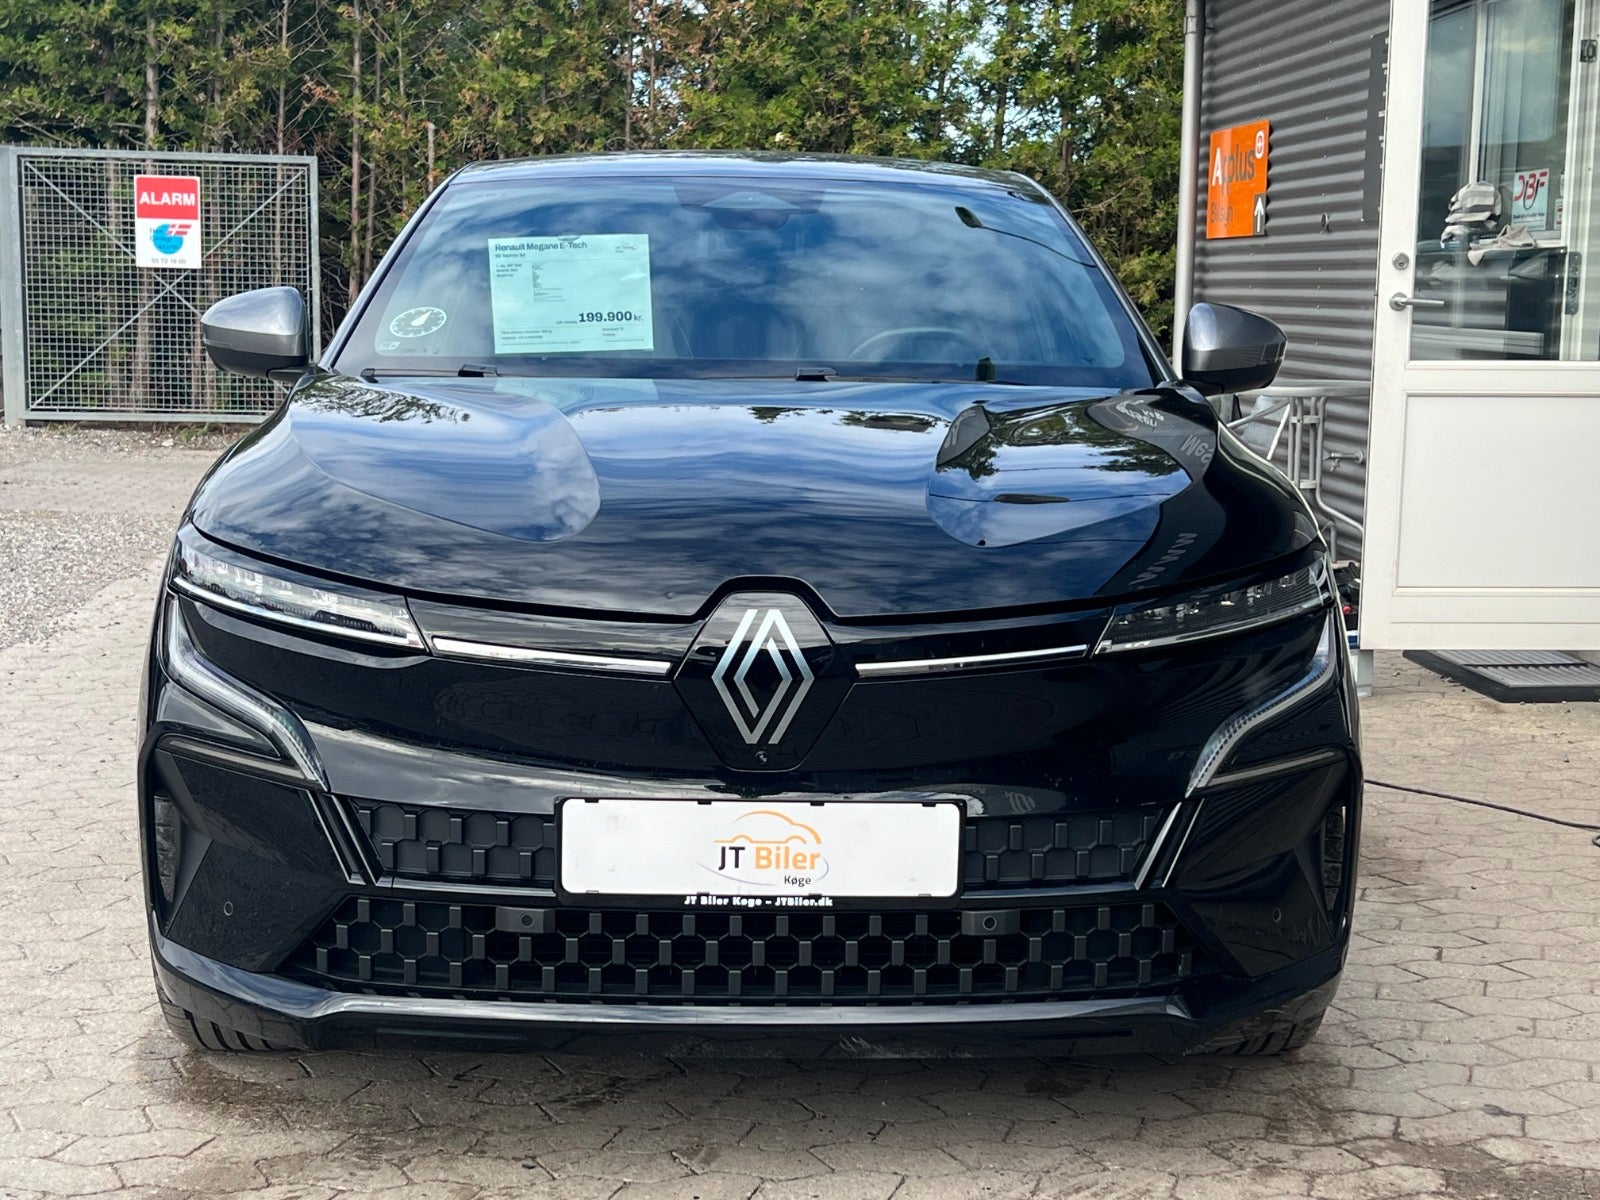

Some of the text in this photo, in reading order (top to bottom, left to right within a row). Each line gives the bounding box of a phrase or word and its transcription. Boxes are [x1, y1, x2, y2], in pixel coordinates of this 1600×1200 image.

[139, 191, 196, 207] ALARM
[495, 241, 588, 252] Renault Megane E-Tech
[578, 311, 632, 323] 199.900
[633, 314, 644, 322] kr.
[718, 846, 820, 871] JT Biler
[784, 875, 812, 888] Køge
[684, 896, 697, 906] JT
[700, 896, 730, 906] Biler
[775, 897, 834, 907] JTBiler.dk
